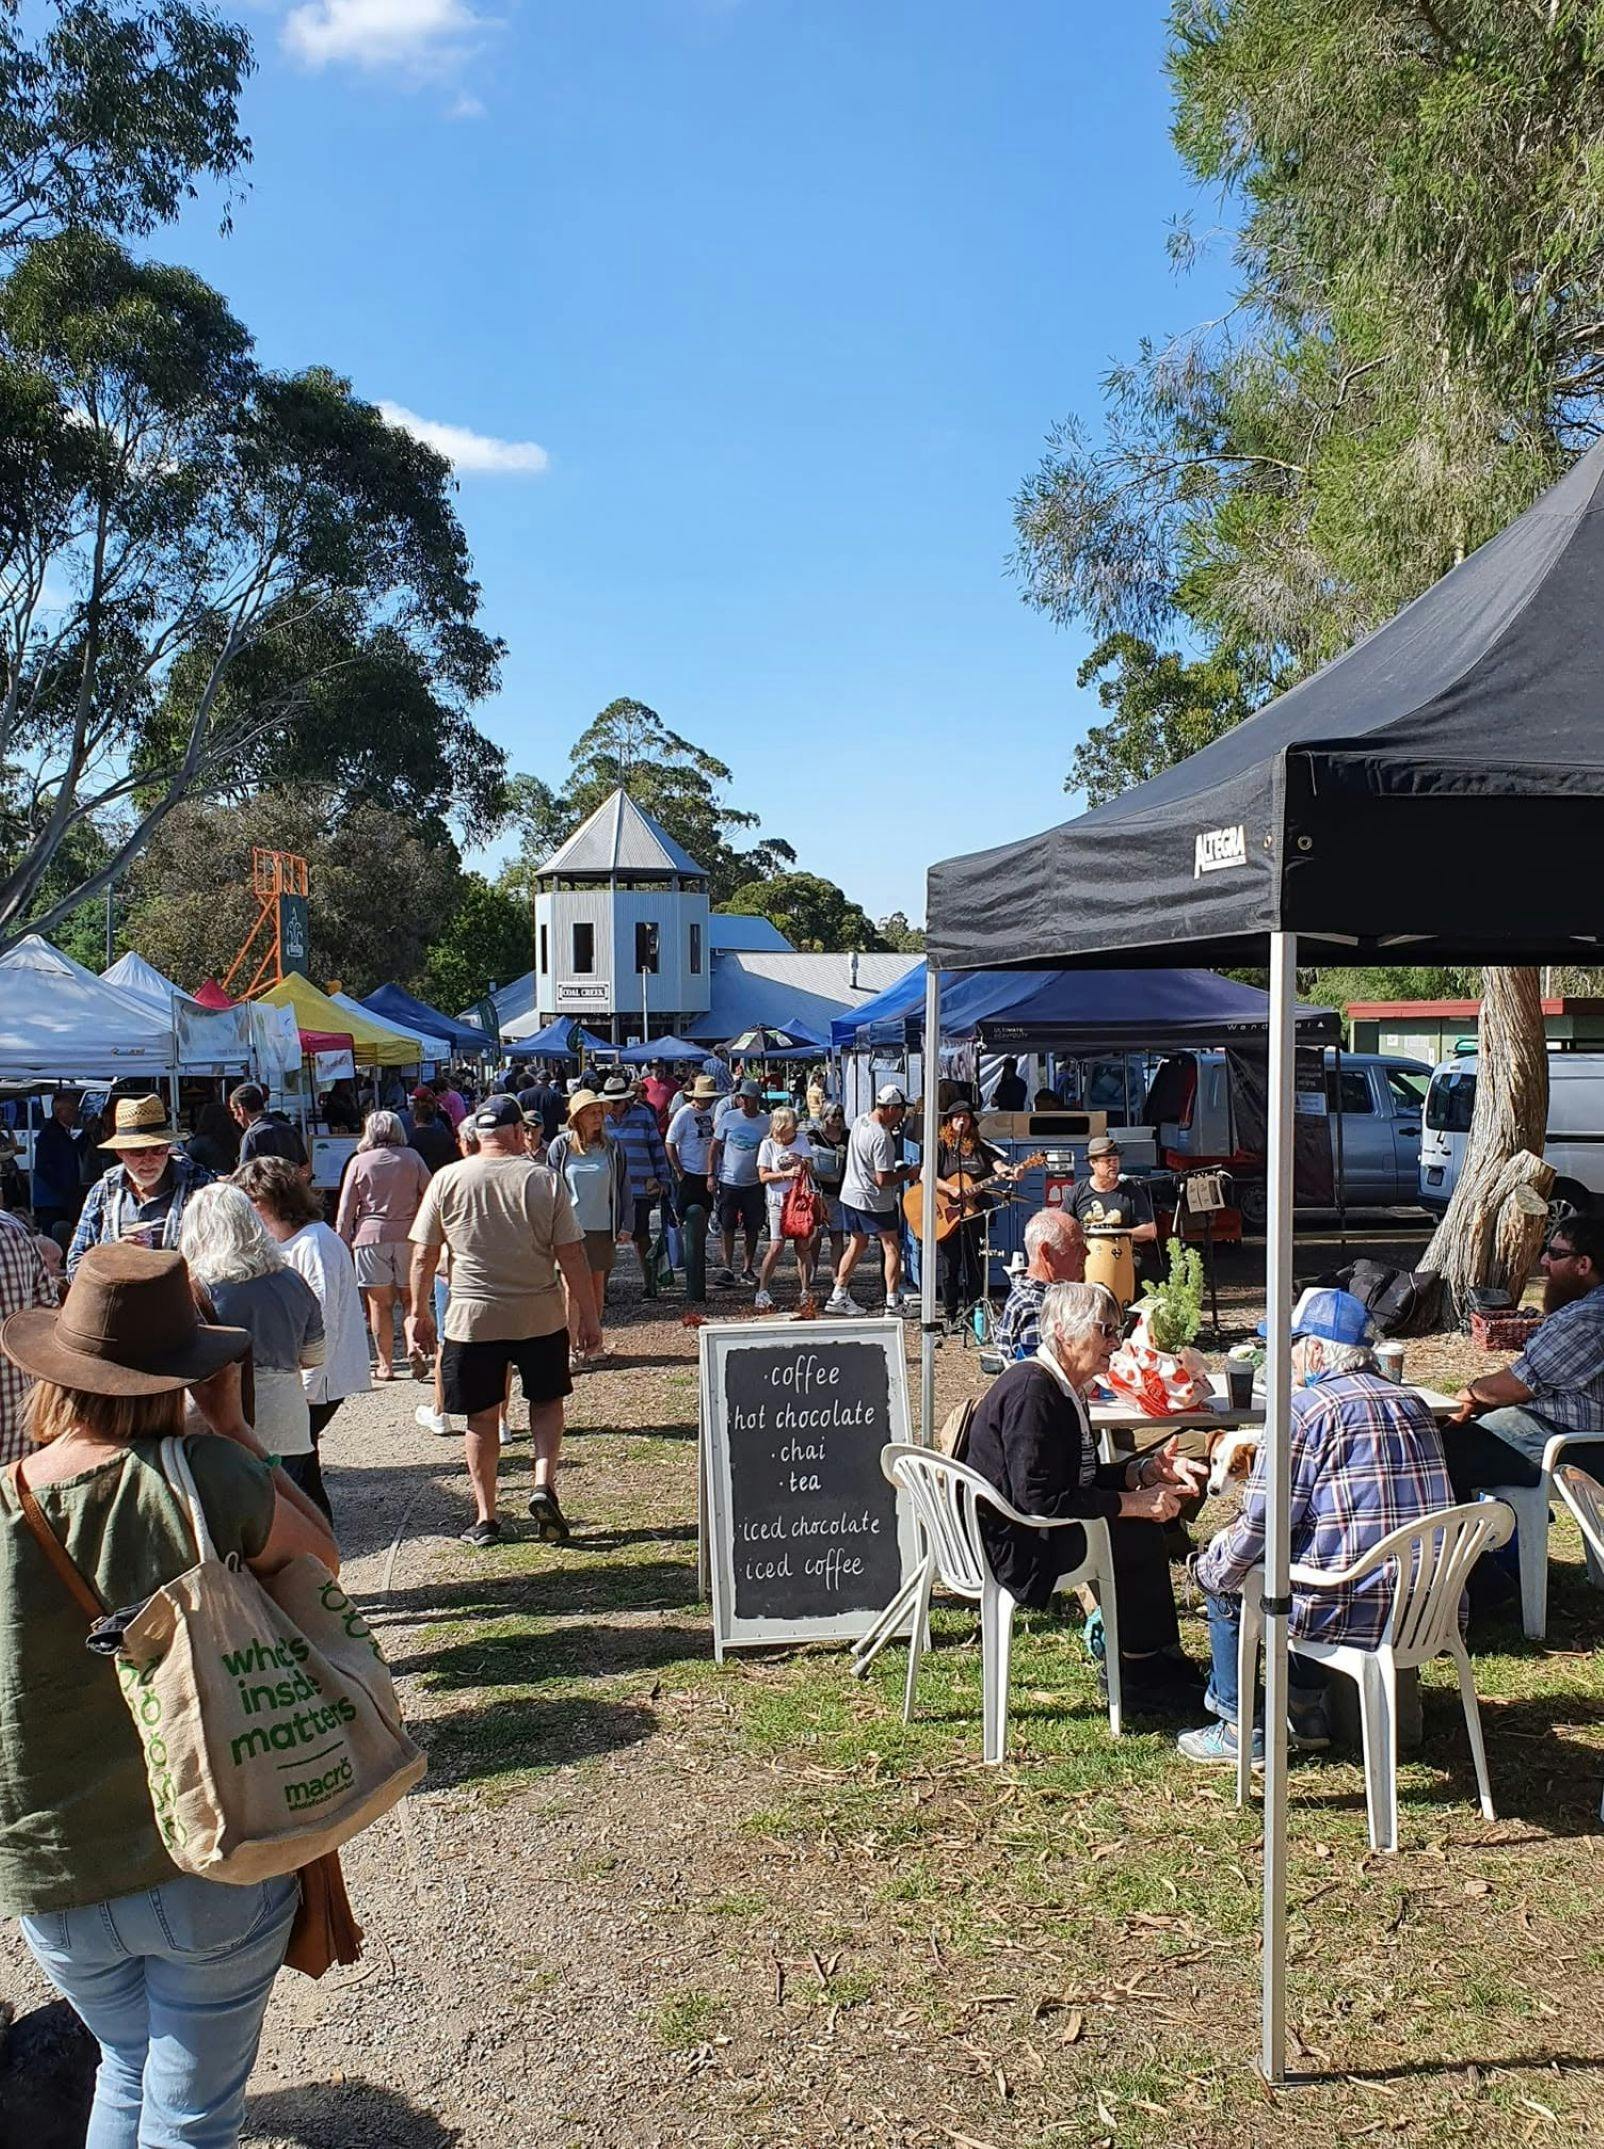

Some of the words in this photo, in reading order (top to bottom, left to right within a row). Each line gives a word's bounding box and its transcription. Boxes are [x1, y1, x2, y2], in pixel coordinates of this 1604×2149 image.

[563, 988, 581, 996] COAL
[581, 988, 604, 996] CREEK
[770, 1354, 840, 1394] coffee
[734, 1404, 766, 1430] hot
[775, 1400, 875, 1429] chocolate
[781, 1435, 826, 1462] chai
[789, 1471, 821, 1492] tea
[743, 1515, 786, 1541] iced
[791, 1510, 880, 1537] chocolate
[745, 1552, 792, 1579] iced
[804, 1548, 864, 1590] coffee
[230, 1696, 357, 1766] matters
[284, 1757, 353, 1803] macro
